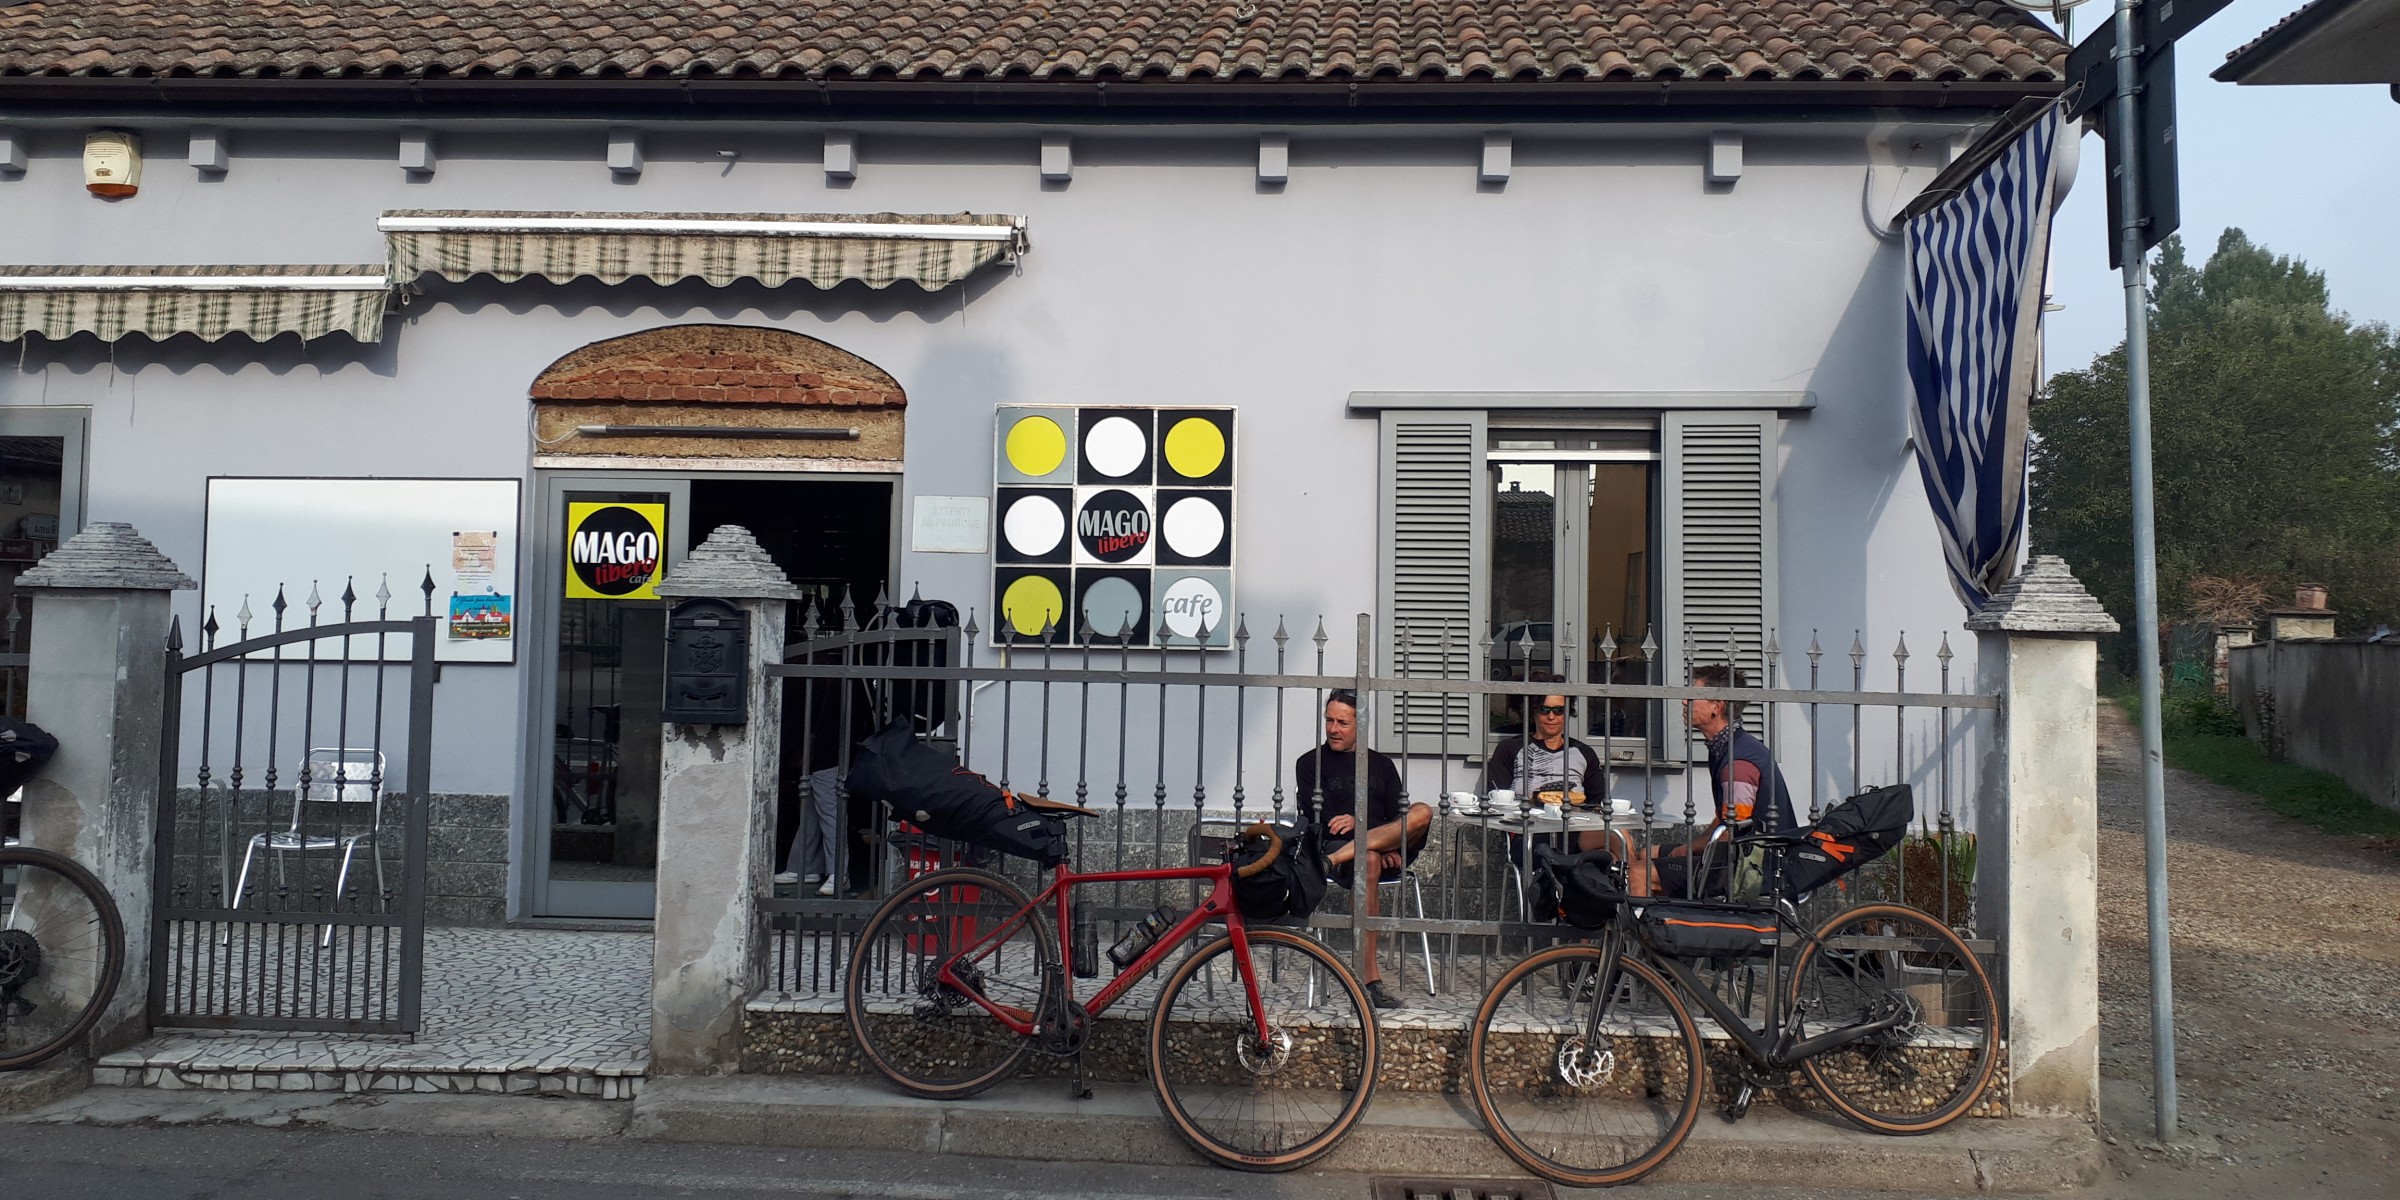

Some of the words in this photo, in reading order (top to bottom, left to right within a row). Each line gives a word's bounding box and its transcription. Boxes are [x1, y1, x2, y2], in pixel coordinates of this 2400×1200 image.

[1079, 509, 1149, 537] MAGO
[573, 531, 658, 564] MAGO
[1098, 530, 1149, 555] libero
[595, 557, 656, 586] libero
[629, 573, 653, 585] cafe
[1162, 593, 1213, 616] cafe
